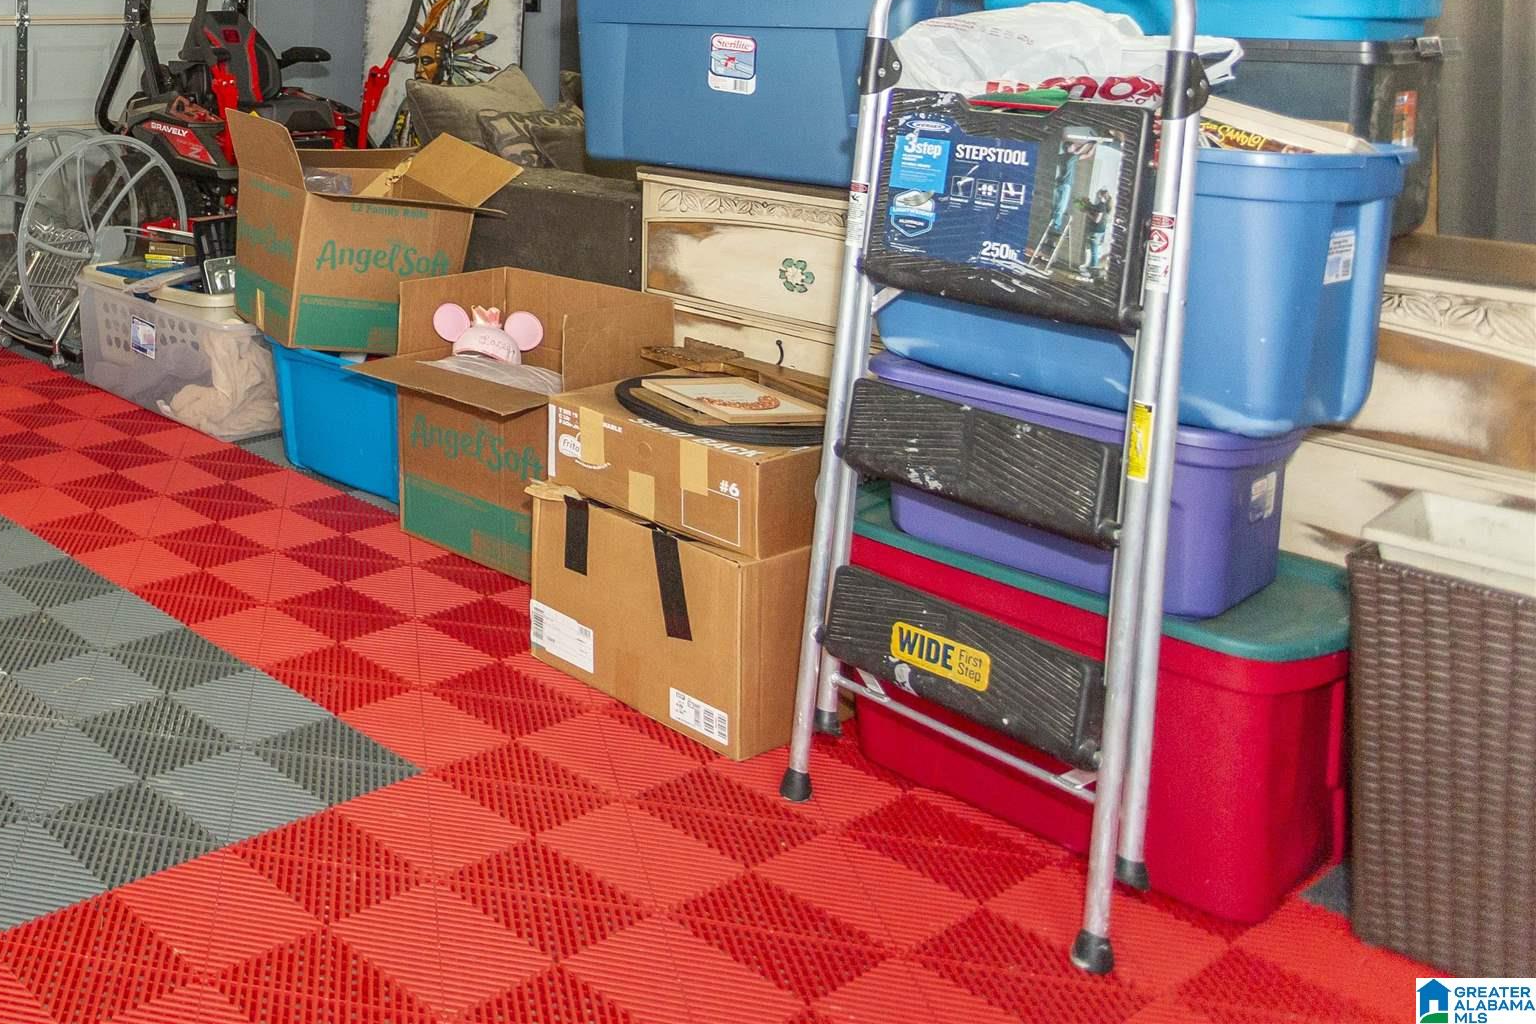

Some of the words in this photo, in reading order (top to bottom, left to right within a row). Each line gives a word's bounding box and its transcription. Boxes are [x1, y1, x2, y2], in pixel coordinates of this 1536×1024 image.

[716, 39, 751, 50] Sterilite
[955, 143, 1030, 166] STEPSTOOL
[315, 239, 401, 273] Angel
[398, 247, 449, 276] Soft
[410, 409, 488, 463] Angel
[485, 432, 544, 482] Soft
[719, 480, 740, 497] #6
[897, 626, 955, 671] WIDE
[958, 649, 983, 669] First
[956, 662, 982, 684] Step
